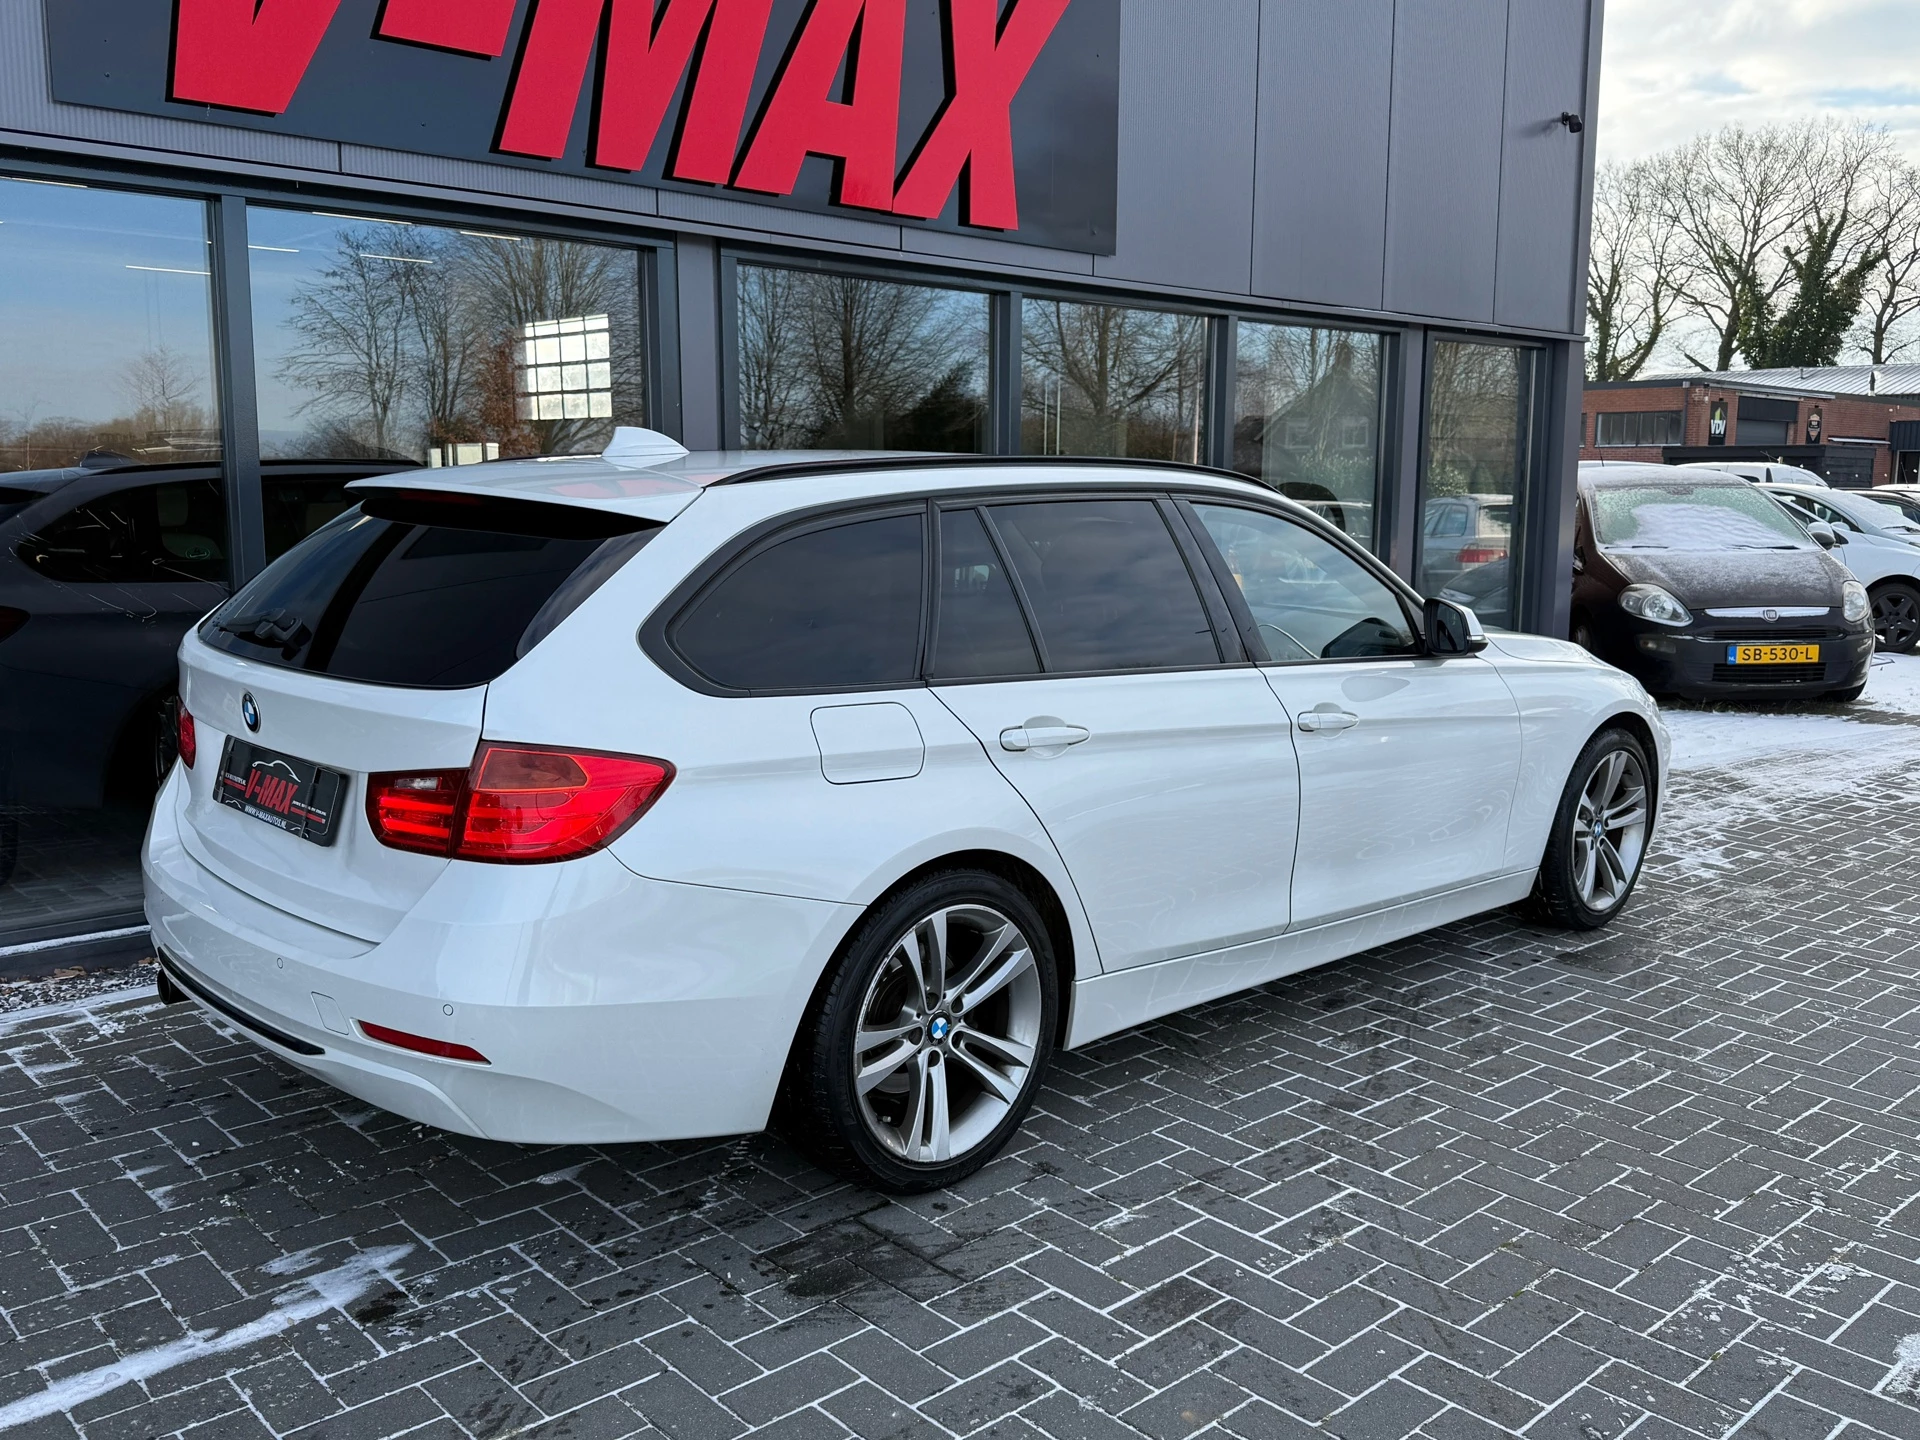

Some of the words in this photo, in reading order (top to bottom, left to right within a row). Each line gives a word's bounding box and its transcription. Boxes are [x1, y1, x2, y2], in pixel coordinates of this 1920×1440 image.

[1711, 419, 1726, 434] VDV
[1742, 647, 1813, 661] SB-530-L
[244, 768, 299, 815] V-MAX
